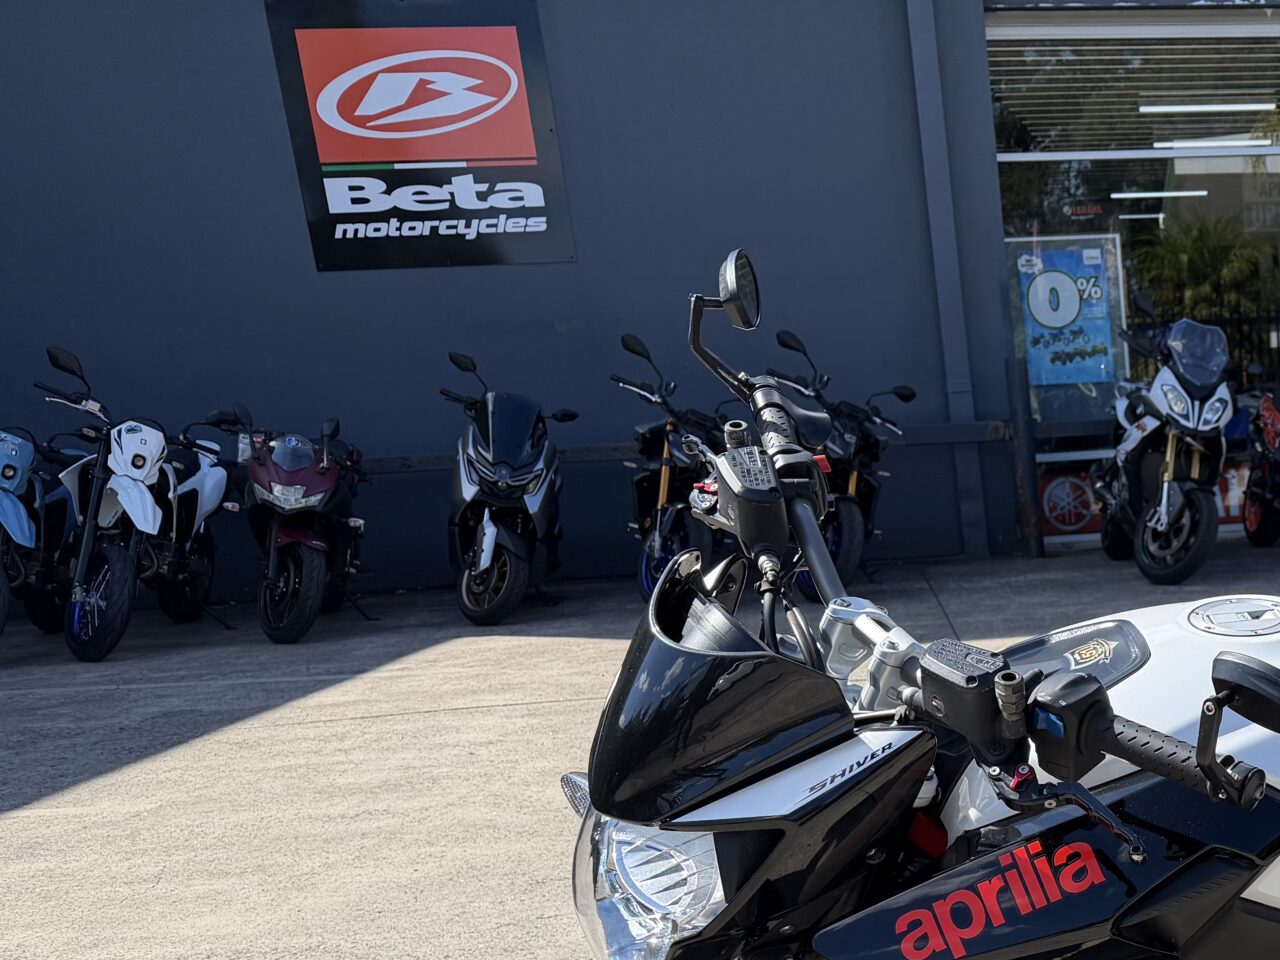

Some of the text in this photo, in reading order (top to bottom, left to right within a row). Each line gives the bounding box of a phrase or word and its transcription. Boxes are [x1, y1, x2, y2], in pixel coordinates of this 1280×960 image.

[322, 173, 546, 214] Beta
[334, 214, 547, 240] motorcycles
[1027, 270, 1104, 329] 0%
[797, 742, 895, 799] SHIVER
